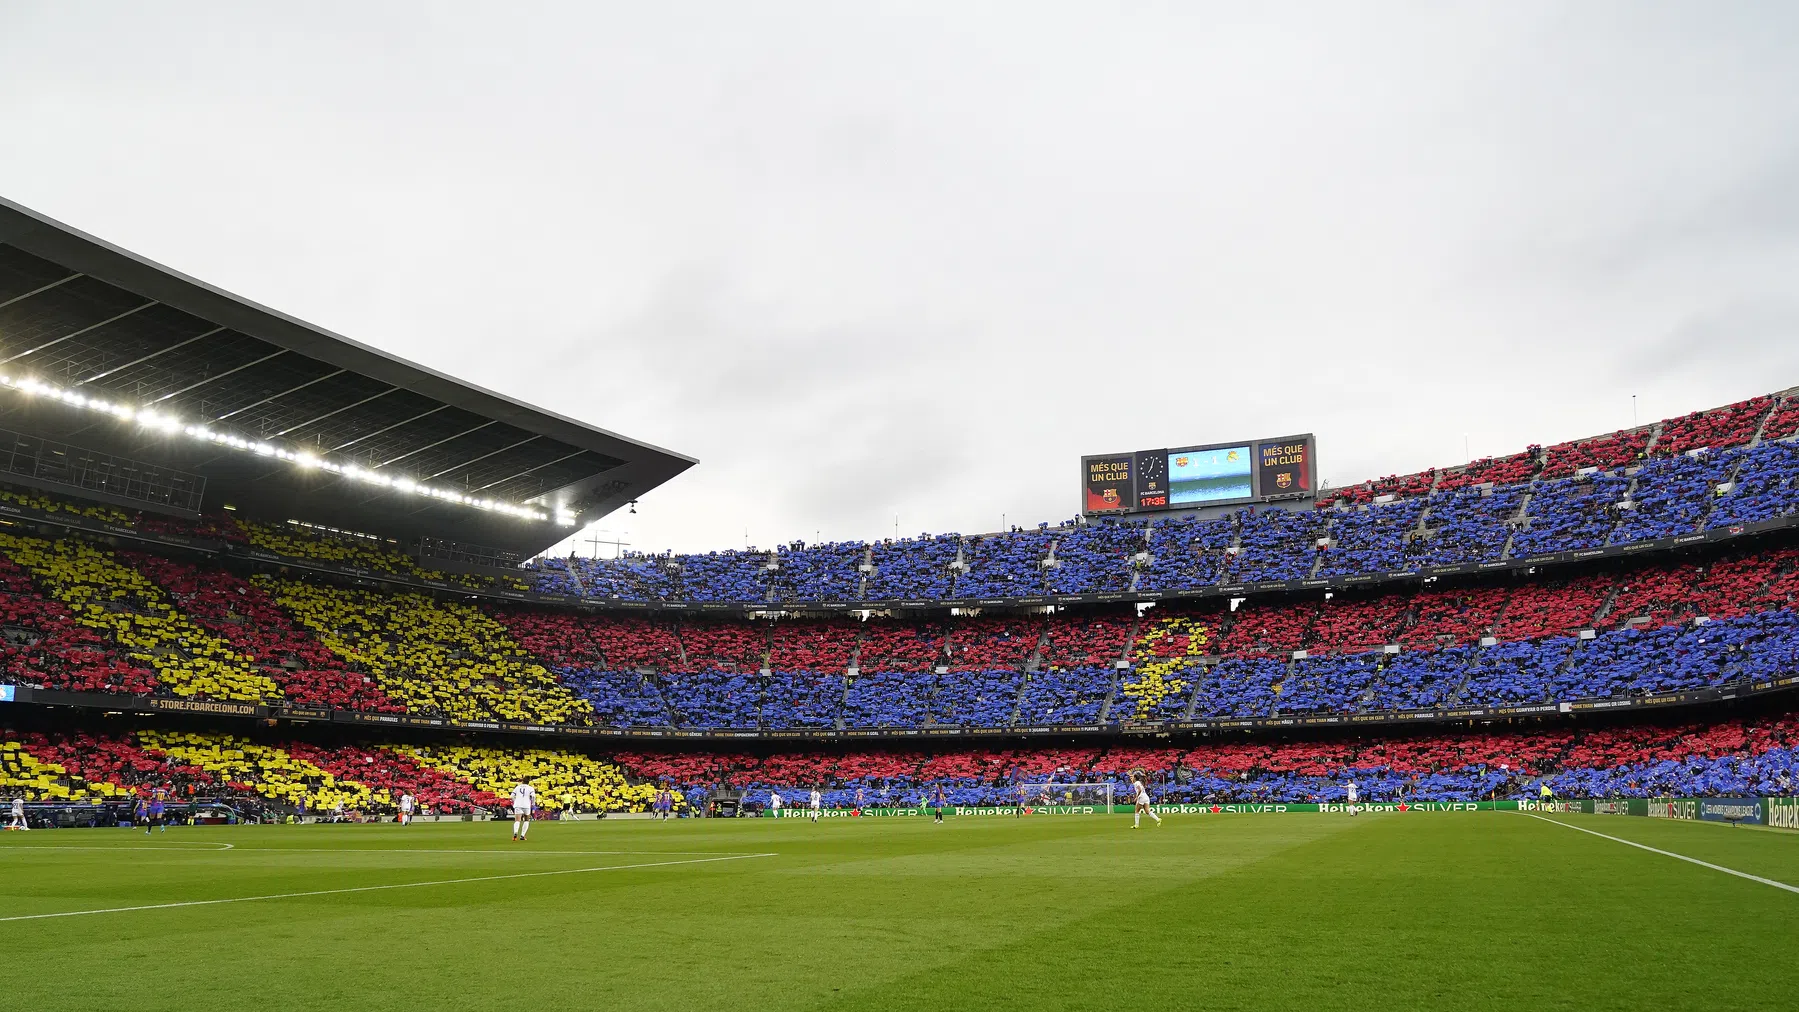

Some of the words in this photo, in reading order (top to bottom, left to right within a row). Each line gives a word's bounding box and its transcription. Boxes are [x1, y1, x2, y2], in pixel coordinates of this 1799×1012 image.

[1263, 446, 1282, 456] MÉS
[1284, 444, 1303, 455] QUE
[1265, 457, 1277, 466] UN
[1280, 454, 1303, 465] CLUB
[1090, 461, 1110, 472] MÉS
[1111, 462, 1128, 471] QUE
[1092, 474, 1104, 482] UN
[1106, 472, 1128, 481] CLUB
[1141, 496, 1166, 506] 17:35
[159, 700, 255, 715] STORE.FCBARCELONA.COM
[520, 788, 525, 798] 4
[864, 809, 918, 817] SILVER
[1139, 804, 1206, 813] eineken
[1222, 805, 1287, 813] SILVER
[1613, 801, 1629, 815] SILVER
[1648, 797, 1668, 818] Heineken
[1673, 801, 1695, 820] SILVER
